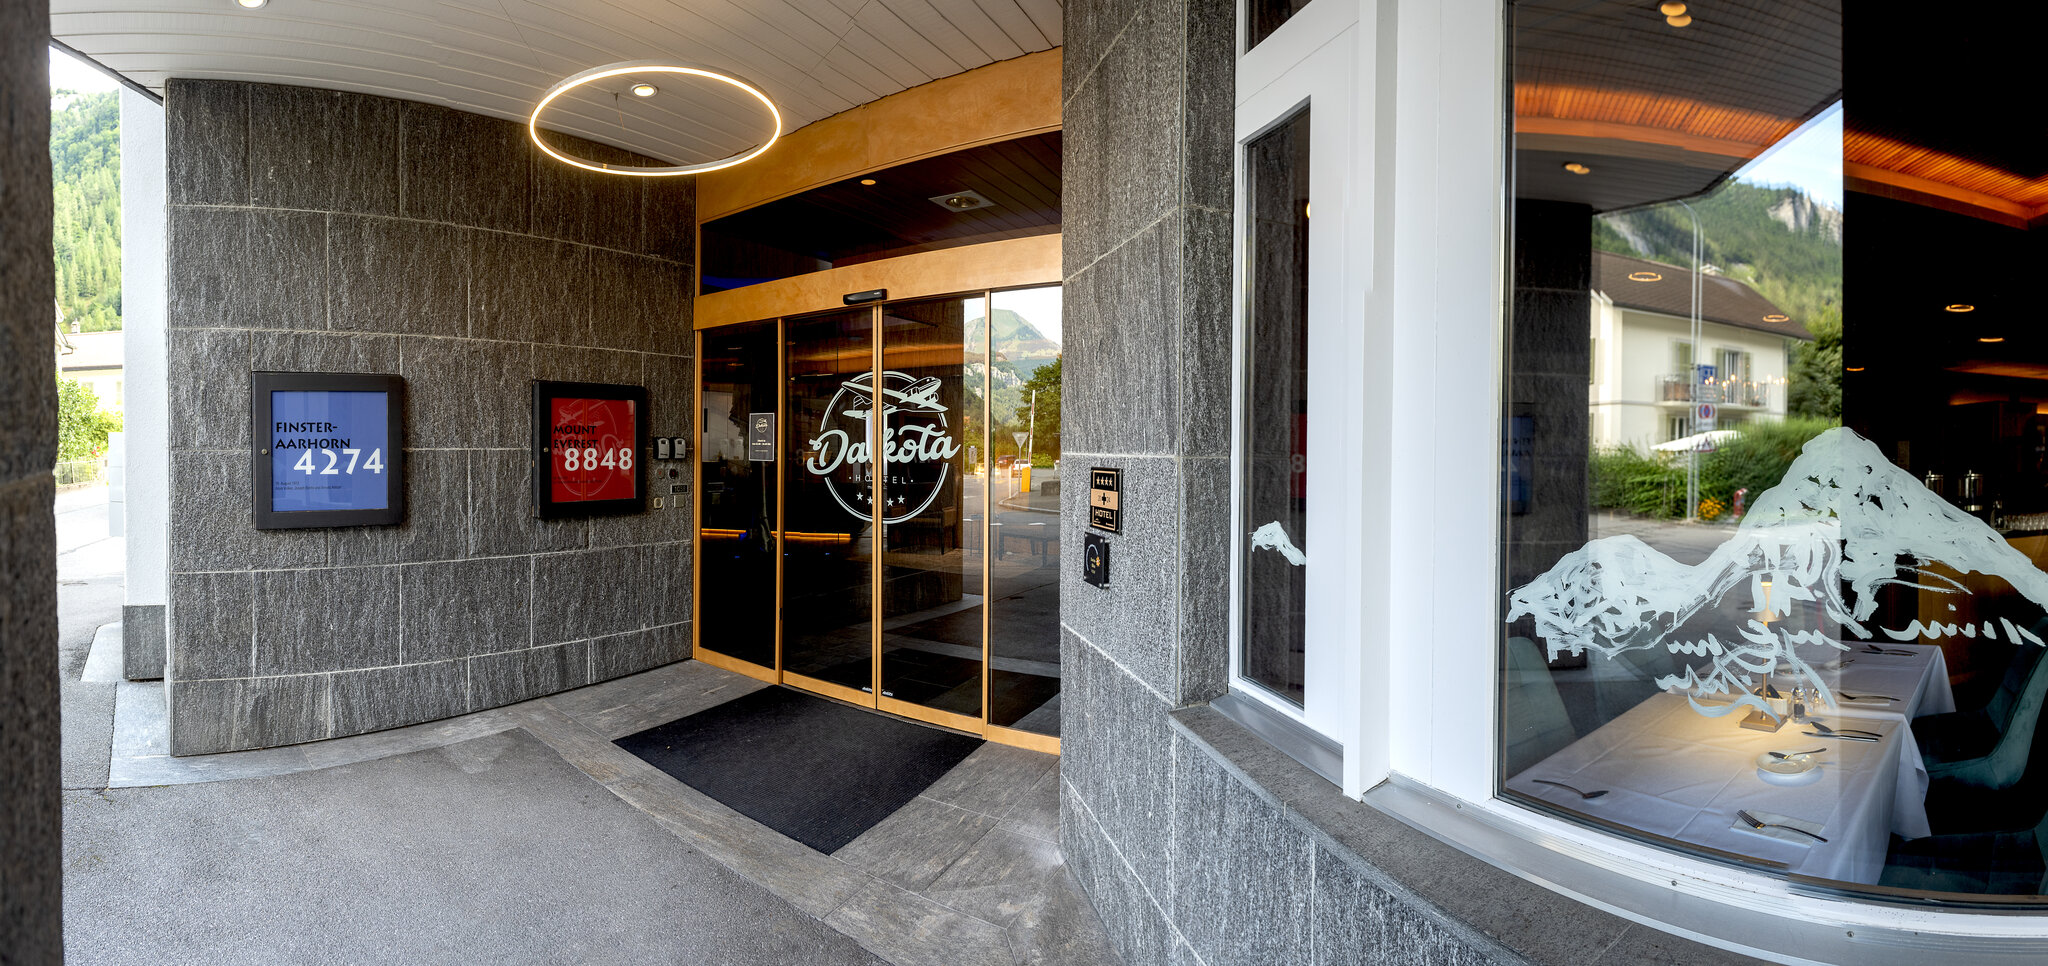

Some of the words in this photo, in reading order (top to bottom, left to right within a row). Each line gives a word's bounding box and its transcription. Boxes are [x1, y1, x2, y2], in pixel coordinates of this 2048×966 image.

[276, 422, 338, 432] FINSTER-
[553, 425, 597, 435] MOUNT
[275, 438, 350, 449] AARHORN
[553, 439, 598, 449] EVEREST
[806, 423, 962, 476] Dakota
[293, 448, 384, 475] 4274
[564, 447, 633, 472] 8848
[1095, 509, 1113, 520] HOTEL
